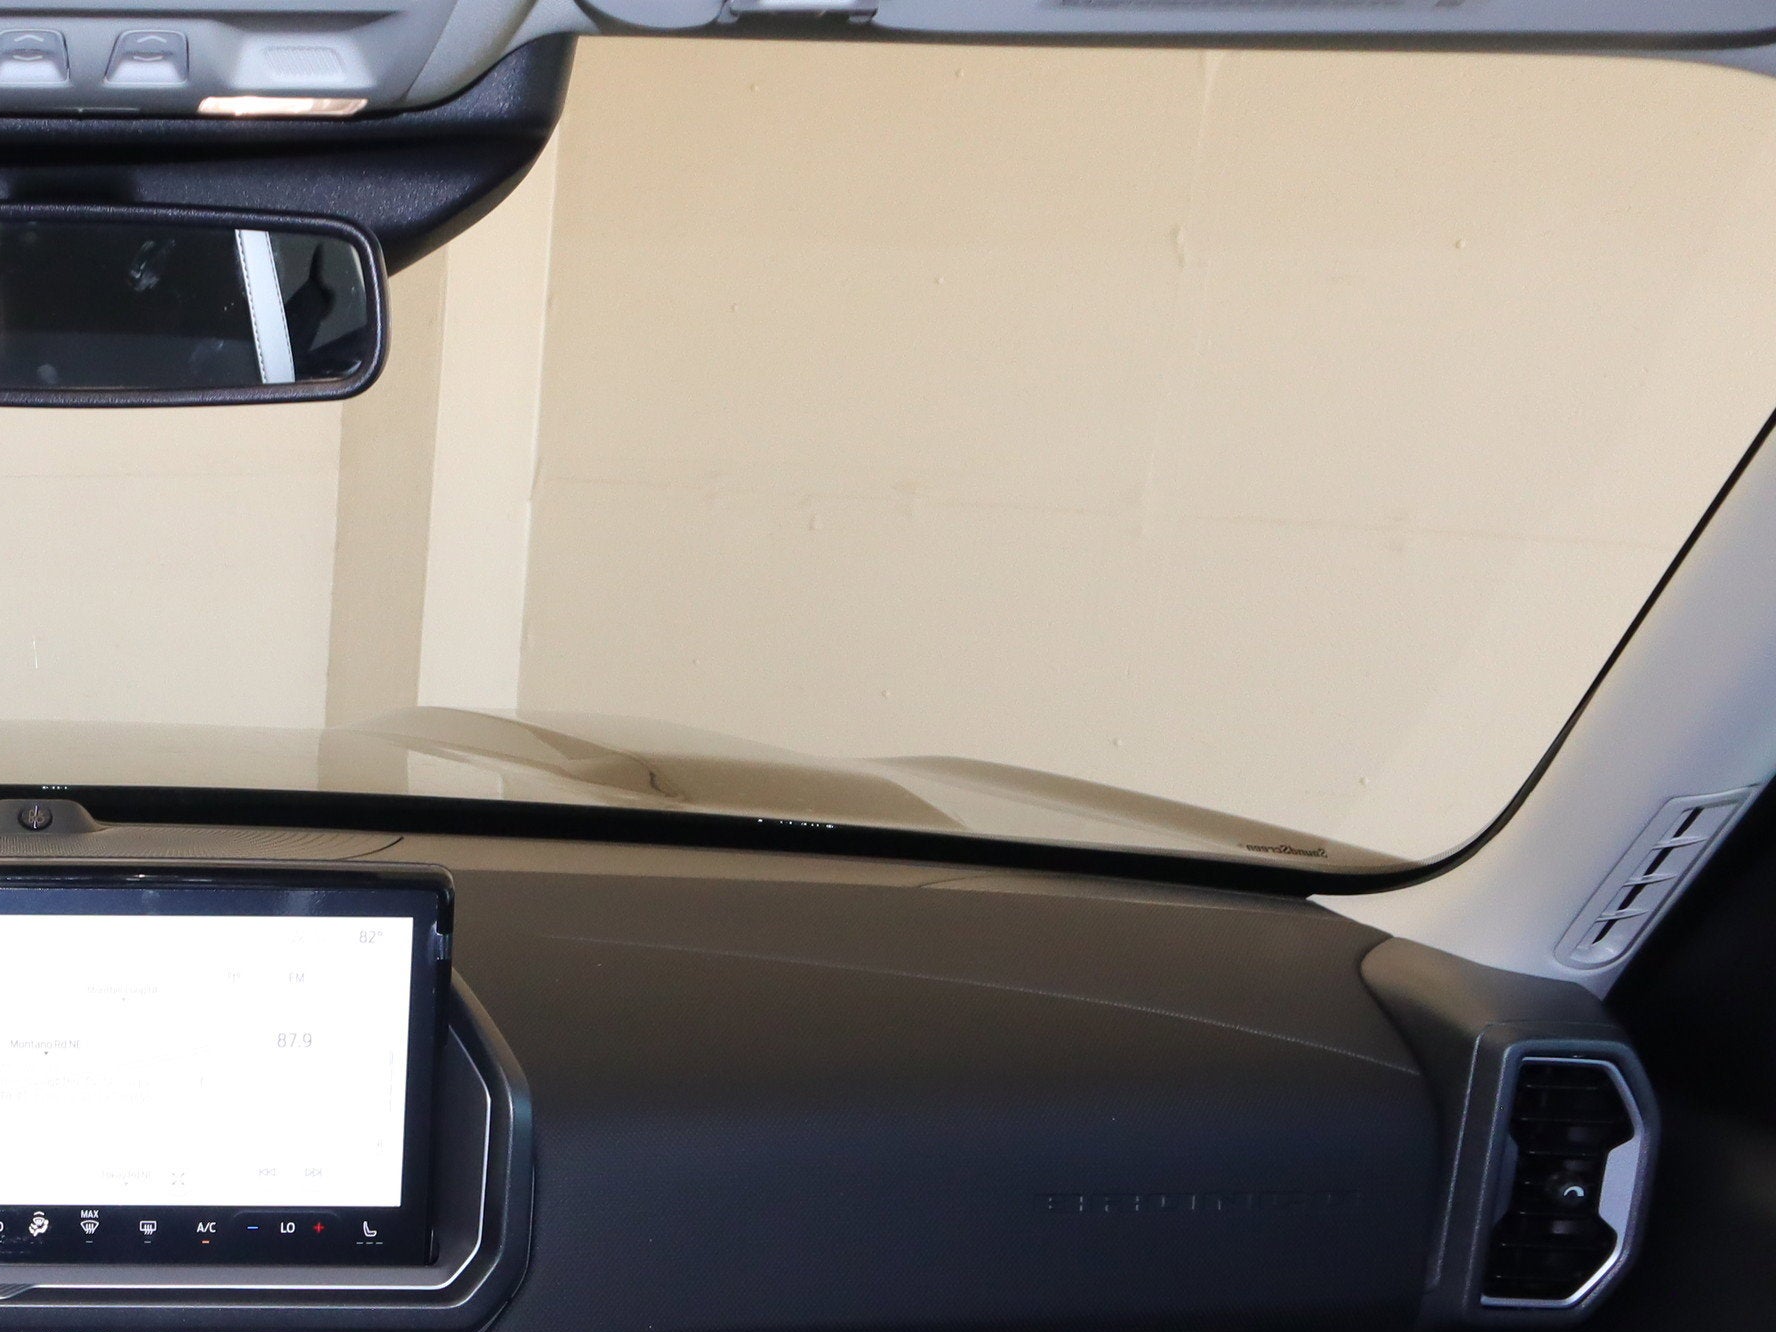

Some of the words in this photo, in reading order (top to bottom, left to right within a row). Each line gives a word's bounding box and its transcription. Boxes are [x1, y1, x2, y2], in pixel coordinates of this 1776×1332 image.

[277, 1033, 312, 1048] 87.9
[80, 1210, 99, 1219] MAX
[196, 1222, 216, 1234] A/C
[280, 1222, 295, 1233] LO
